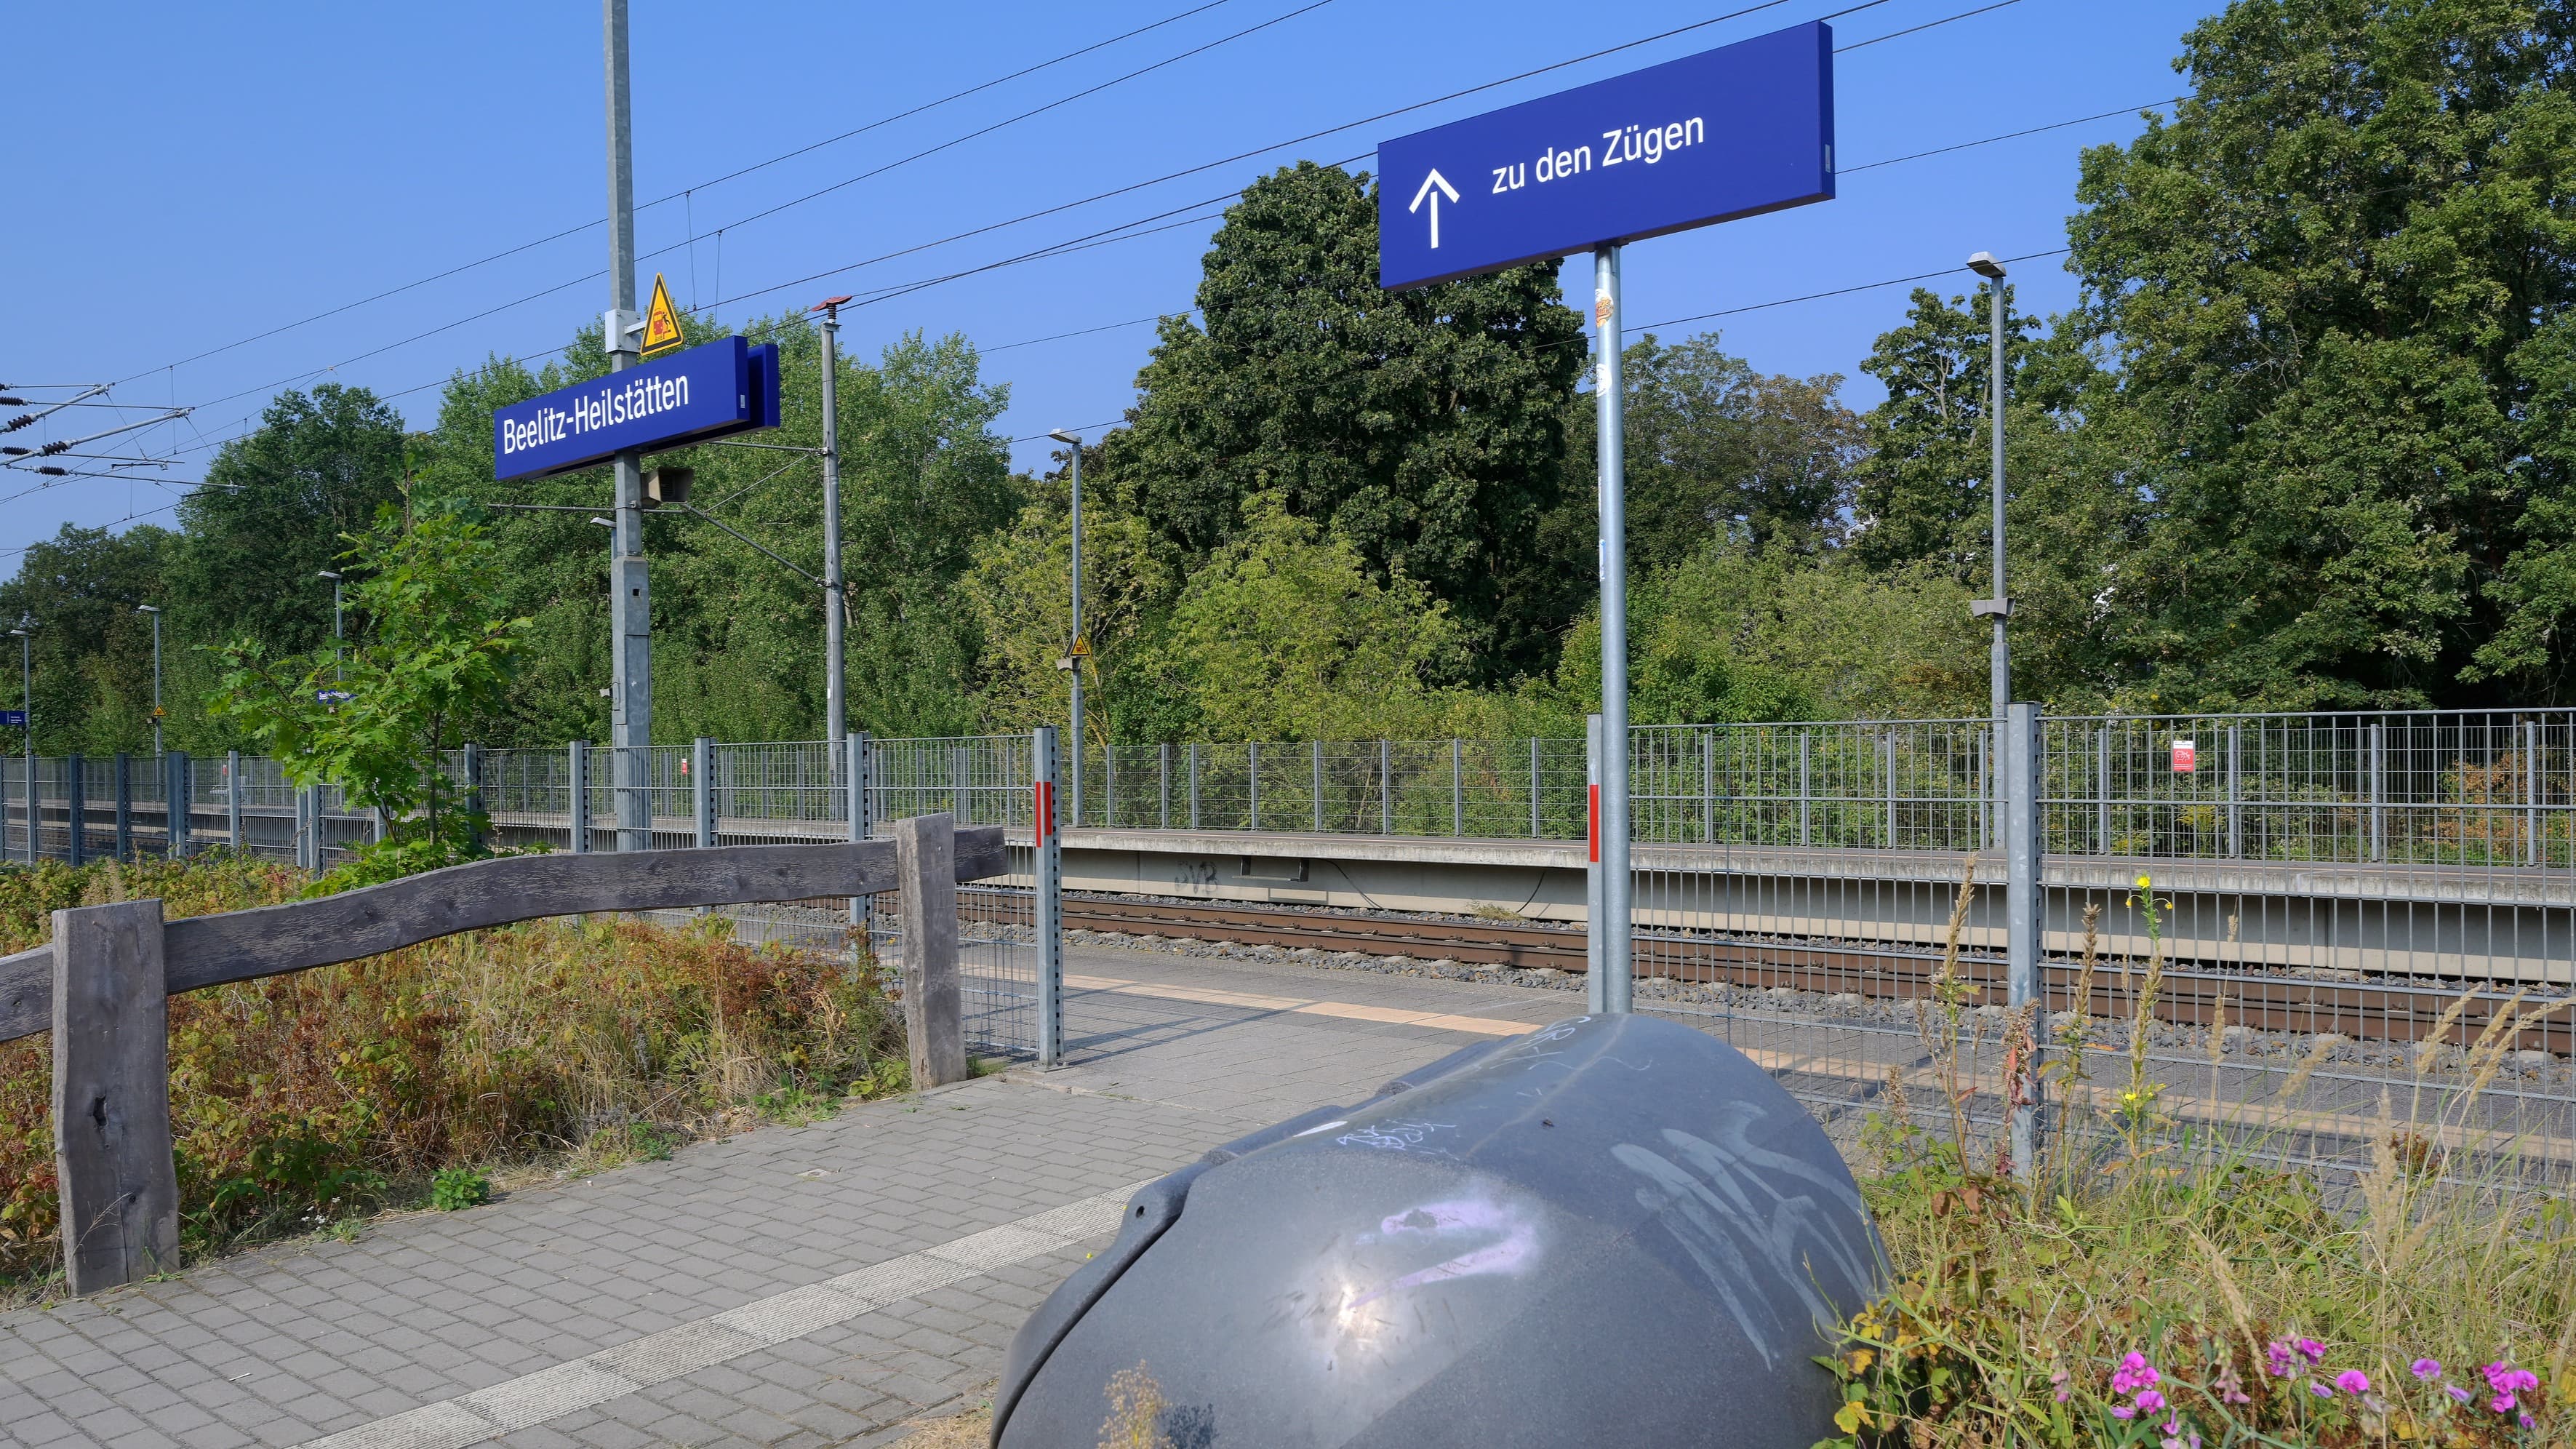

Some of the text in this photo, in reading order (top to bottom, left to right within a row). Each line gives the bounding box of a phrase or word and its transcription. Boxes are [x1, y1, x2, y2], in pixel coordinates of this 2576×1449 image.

[1492, 116, 1704, 194] zu den Zügen
[503, 375, 689, 455] Beelitz-Heilstätten
